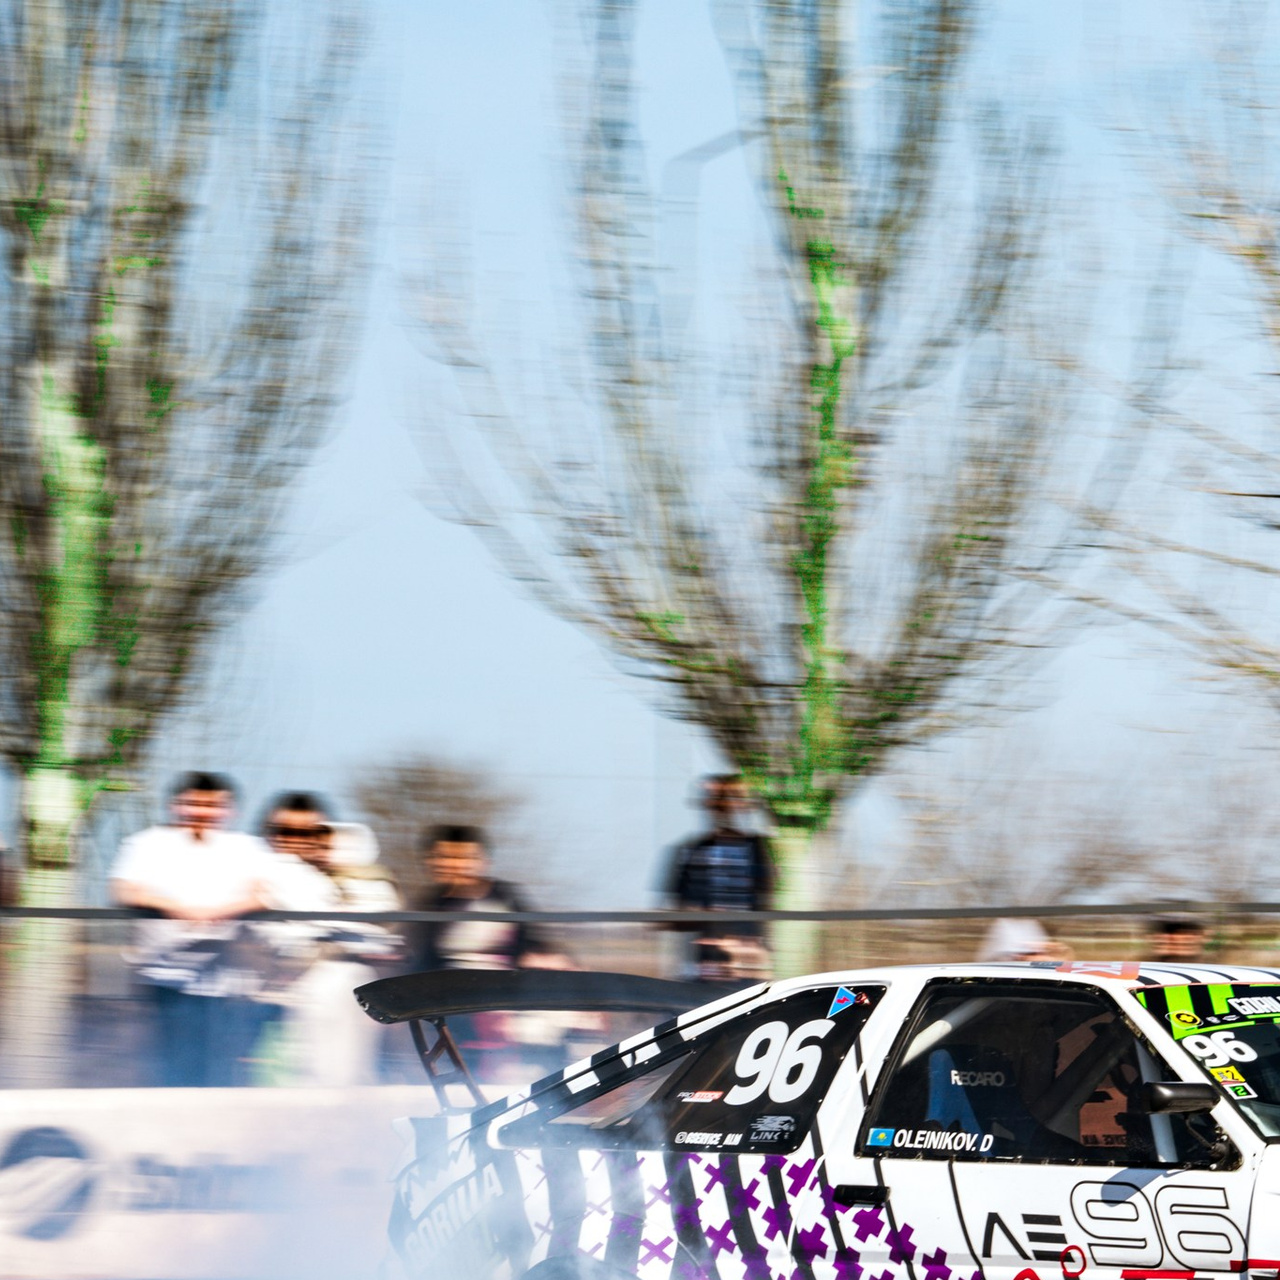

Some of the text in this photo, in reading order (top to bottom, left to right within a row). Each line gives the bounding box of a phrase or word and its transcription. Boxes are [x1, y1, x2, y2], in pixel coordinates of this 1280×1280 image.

[724, 1018, 836, 1105] 96
[1182, 1031, 1258, 1067] 96
[951, 1069, 1005, 1087] RECARO
[893, 1129, 993, 1151] OLEINIKOV. D
[405, 1162, 504, 1256] GORILLA
